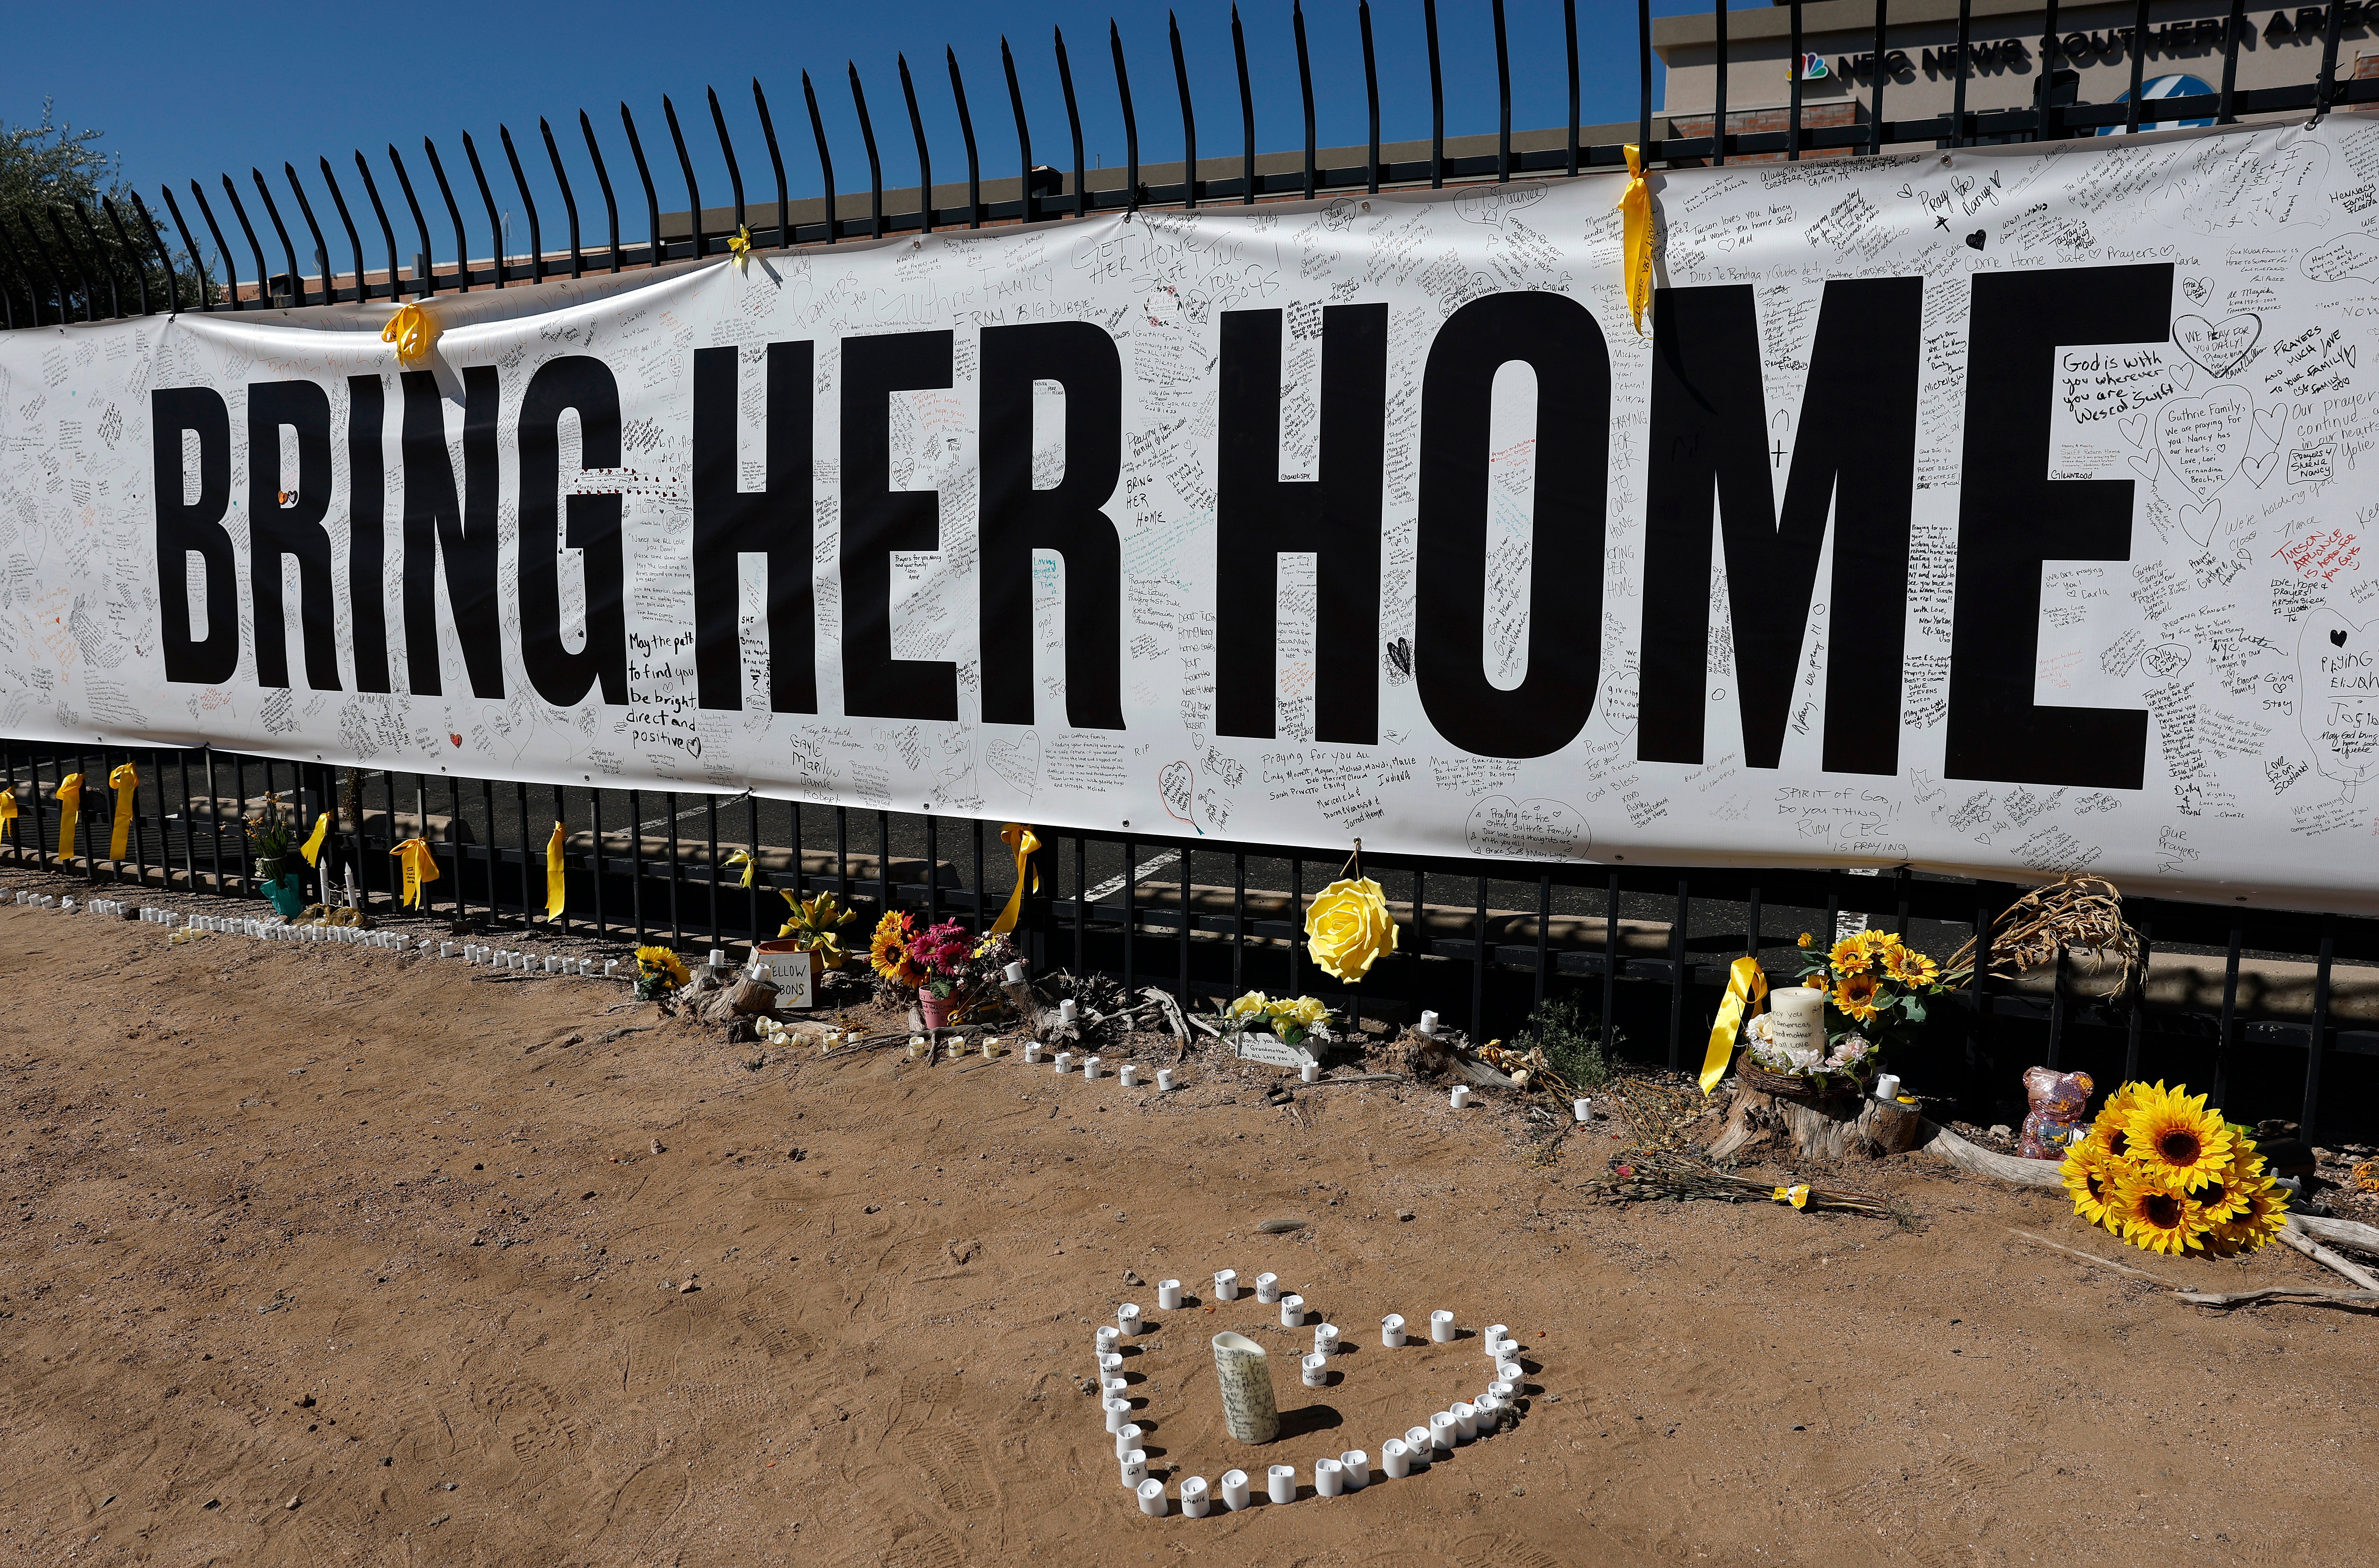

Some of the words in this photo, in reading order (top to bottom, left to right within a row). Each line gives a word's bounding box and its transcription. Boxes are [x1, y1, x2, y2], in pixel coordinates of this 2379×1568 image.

[1922, 39, 2023, 70] NEWS
[1688, 222, 1718, 236] Tucson
[1721, 214, 1741, 226] loves
[1745, 210, 1761, 220] you
[1768, 204, 1792, 219] Nancy
[1694, 234, 1707, 246] and
[1710, 228, 1731, 240] wants
[1735, 225, 1748, 234] you
[1752, 219, 1772, 230] home
[1965, 255, 2002, 272] Come
[2010, 250, 2046, 268] Home
[2057, 251, 2085, 263] Safe
[2107, 246, 2158, 262] Prayers
[851, 291, 867, 312] the
[2185, 331, 2202, 343] WE
[2233, 326, 2250, 335] FOR
[2273, 325, 2321, 357] PRAYERS
[2194, 343, 2211, 353] YOU
[2287, 344, 2317, 366] MUCH
[2063, 352, 2100, 372] God
[2104, 355, 2118, 370] is
[2123, 350, 2162, 369] with
[2062, 378, 2088, 396] you
[2095, 369, 2164, 387] wherever
[2063, 393, 2089, 412] you
[2096, 389, 2130, 401] are
[2132, 383, 2175, 410] Swift
[2168, 407, 2207, 422] Guthrie
[2208, 398, 2246, 415] Family,
[2165, 427, 2179, 436] We
[2195, 419, 2222, 434] praying
[2227, 415, 2242, 424] for
[1610, 430, 1638, 453] FOR
[2167, 438, 2184, 448] you.
[2188, 434, 2212, 442] Nancy
[2185, 444, 2213, 453] hearts.
[1610, 449, 1641, 471] HER
[2180, 457, 2201, 465] Love,
[2202, 453, 2216, 462] Lori
[1610, 475, 1629, 492] TO
[2190, 475, 2215, 483] Beach,
[151, 355, 629, 707] BRING
[692, 321, 1126, 730] HER
[1215, 262, 2175, 790] HOME
[895, 554, 912, 563] Prayers
[929, 554, 942, 563] Nancy
[2076, 567, 2104, 578] praying
[2080, 586, 2110, 599] Carla
[629, 632, 651, 659] May
[651, 634, 672, 650] the
[673, 630, 694, 655] path
[629, 659, 641, 682] to
[642, 662, 672, 679] find
[675, 668, 694, 686] you
[630, 687, 651, 704] be
[655, 689, 697, 714] bright,
[626, 707, 669, 726] direct
[671, 717, 696, 732] and
[632, 729, 685, 750] positive
[801, 724, 819, 737] Keep
[833, 727, 853, 738] faith
[842, 740, 864, 750] Oregon
[1260, 753, 1303, 769] Praying
[1310, 749, 1327, 761] for
[1331, 751, 1351, 765] you
[1239, 1035, 1260, 1045] Nancy
[1303, 1369, 1326, 1381] Tucson
